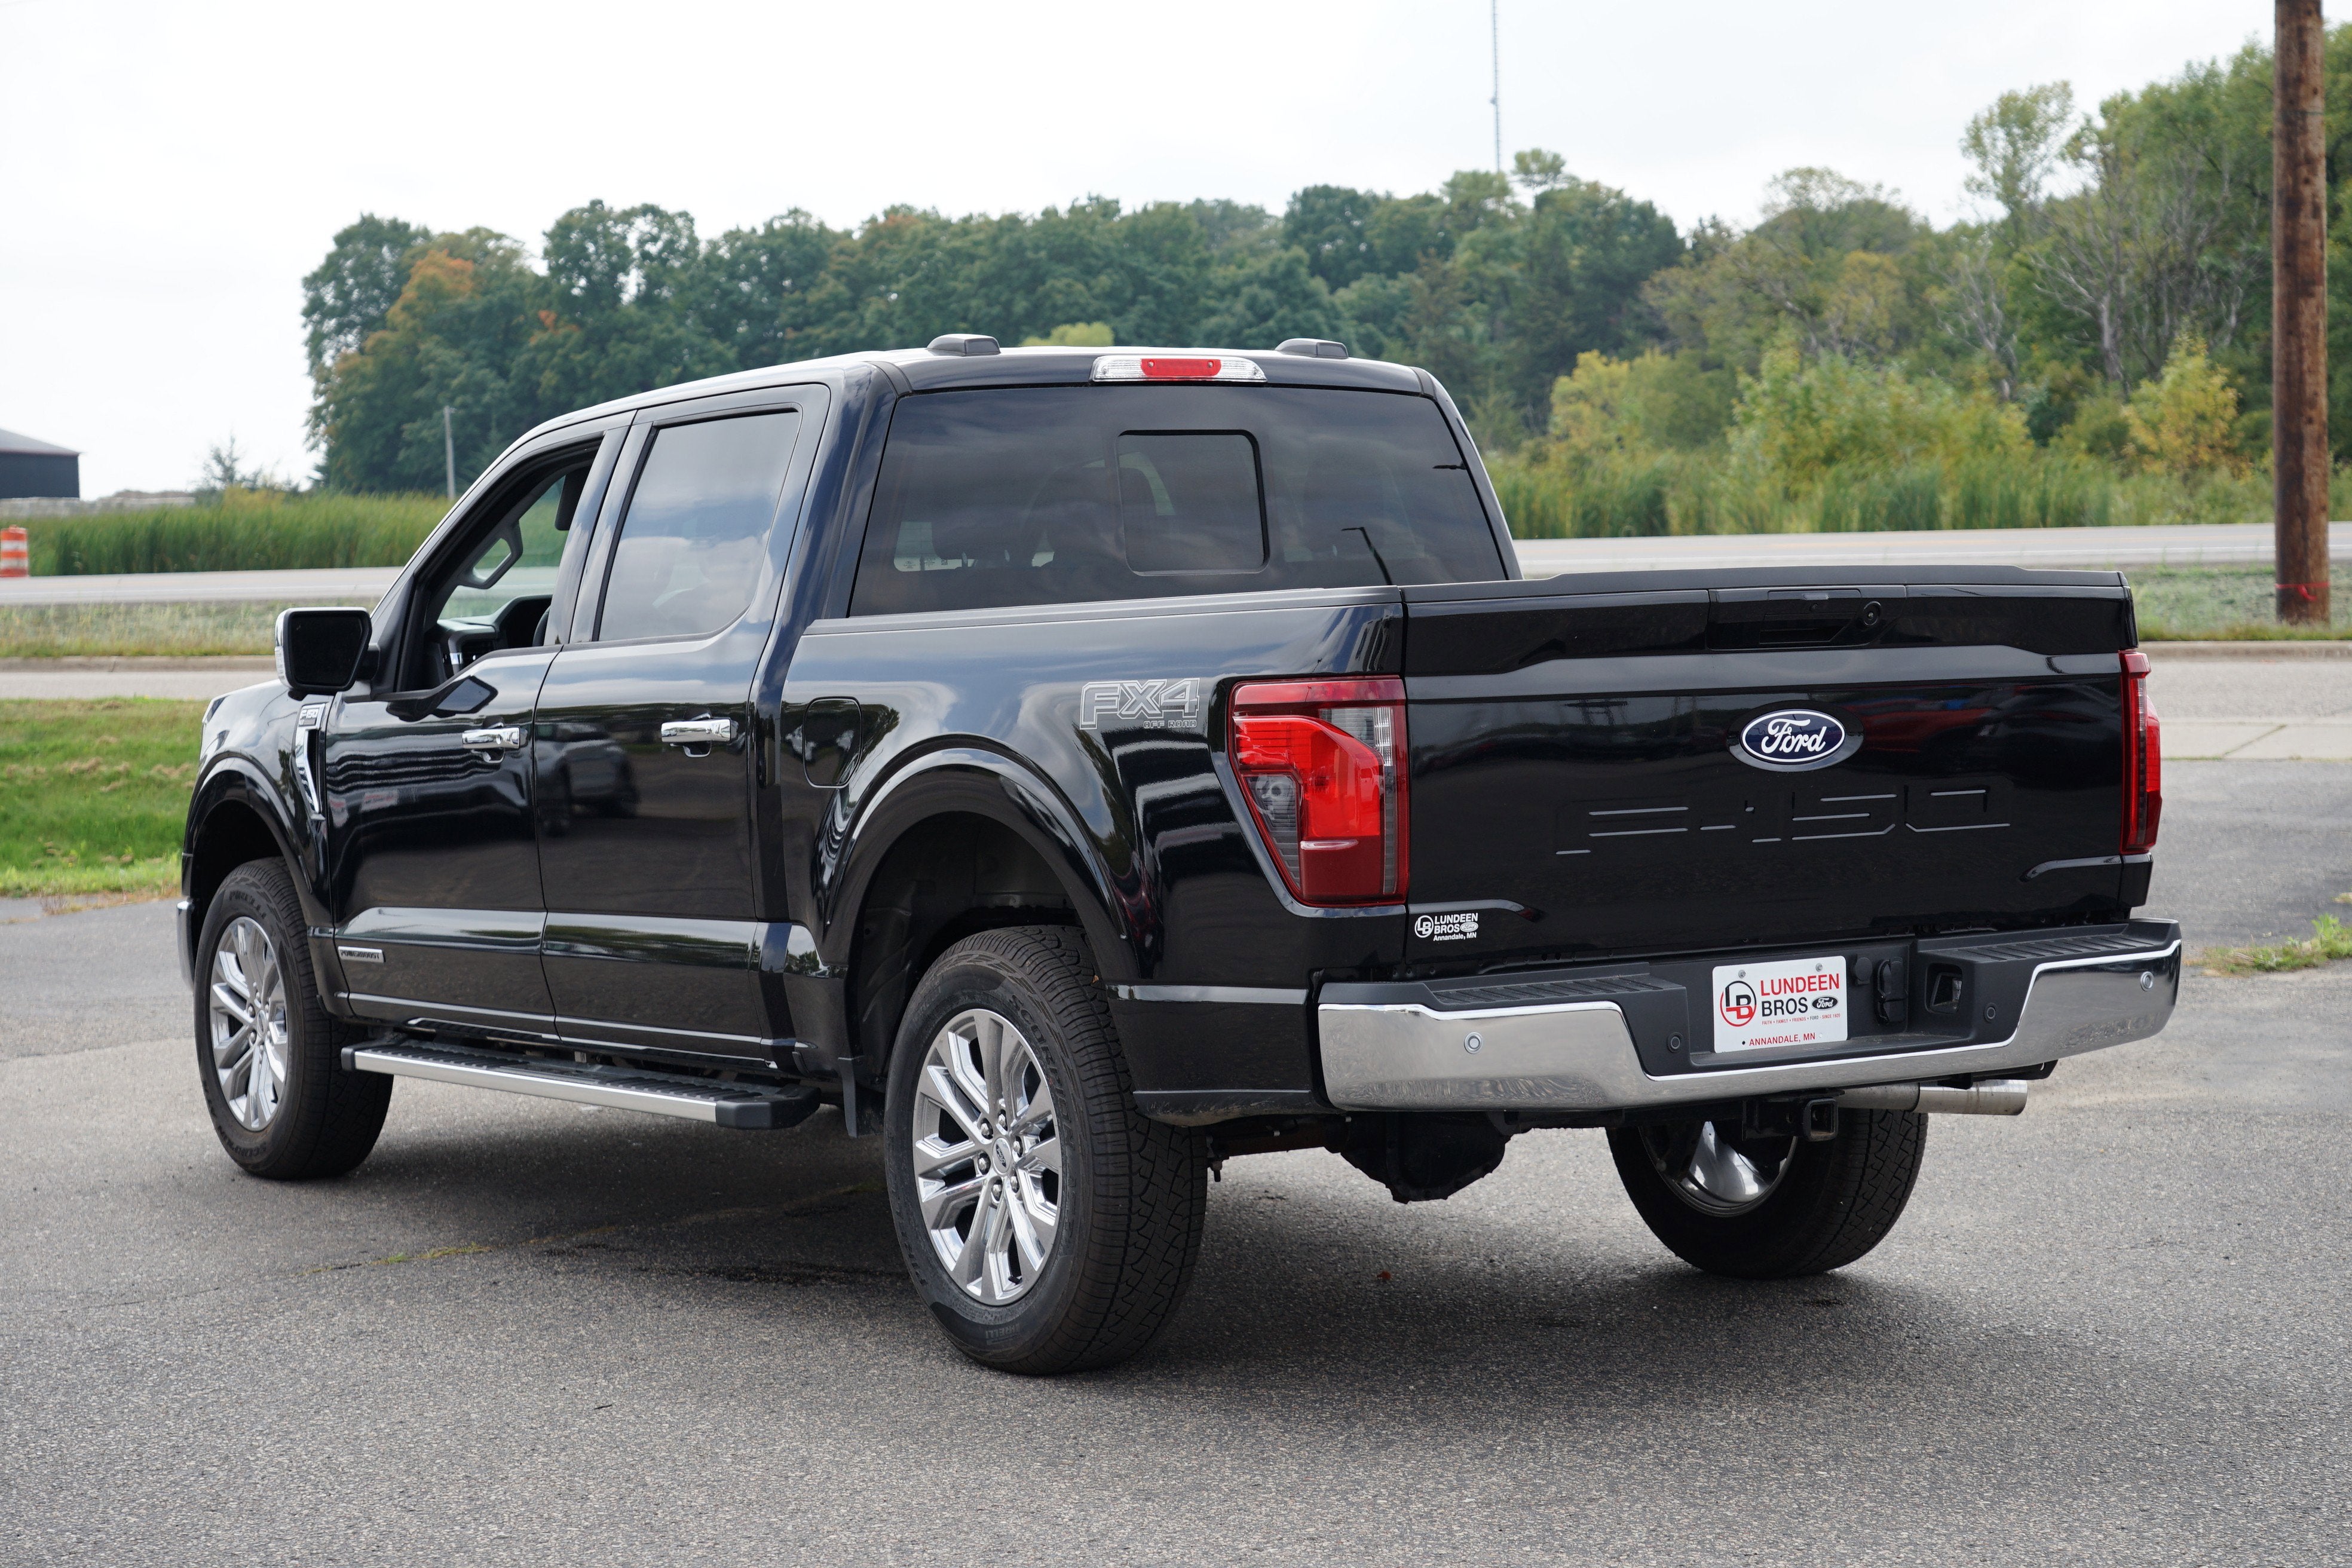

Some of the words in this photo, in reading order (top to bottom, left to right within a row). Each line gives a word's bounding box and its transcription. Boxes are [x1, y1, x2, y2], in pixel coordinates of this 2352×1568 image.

[1080, 678, 1200, 730] FX4
[1143, 720, 1165, 728] OFF
[1168, 719, 1197, 728] ROAD
[1760, 718, 1827, 754] Ford
[1434, 912, 1478, 925] LUNDEEN
[1434, 924, 1460, 934] BROS
[1433, 933, 1466, 941] Annandale,
[1760, 973, 1840, 996] LUNDEEN
[1762, 997, 1808, 1016] BROS
[1749, 1034, 1801, 1046] ANNANDALE,
[1803, 1033, 1815, 1041] MN
